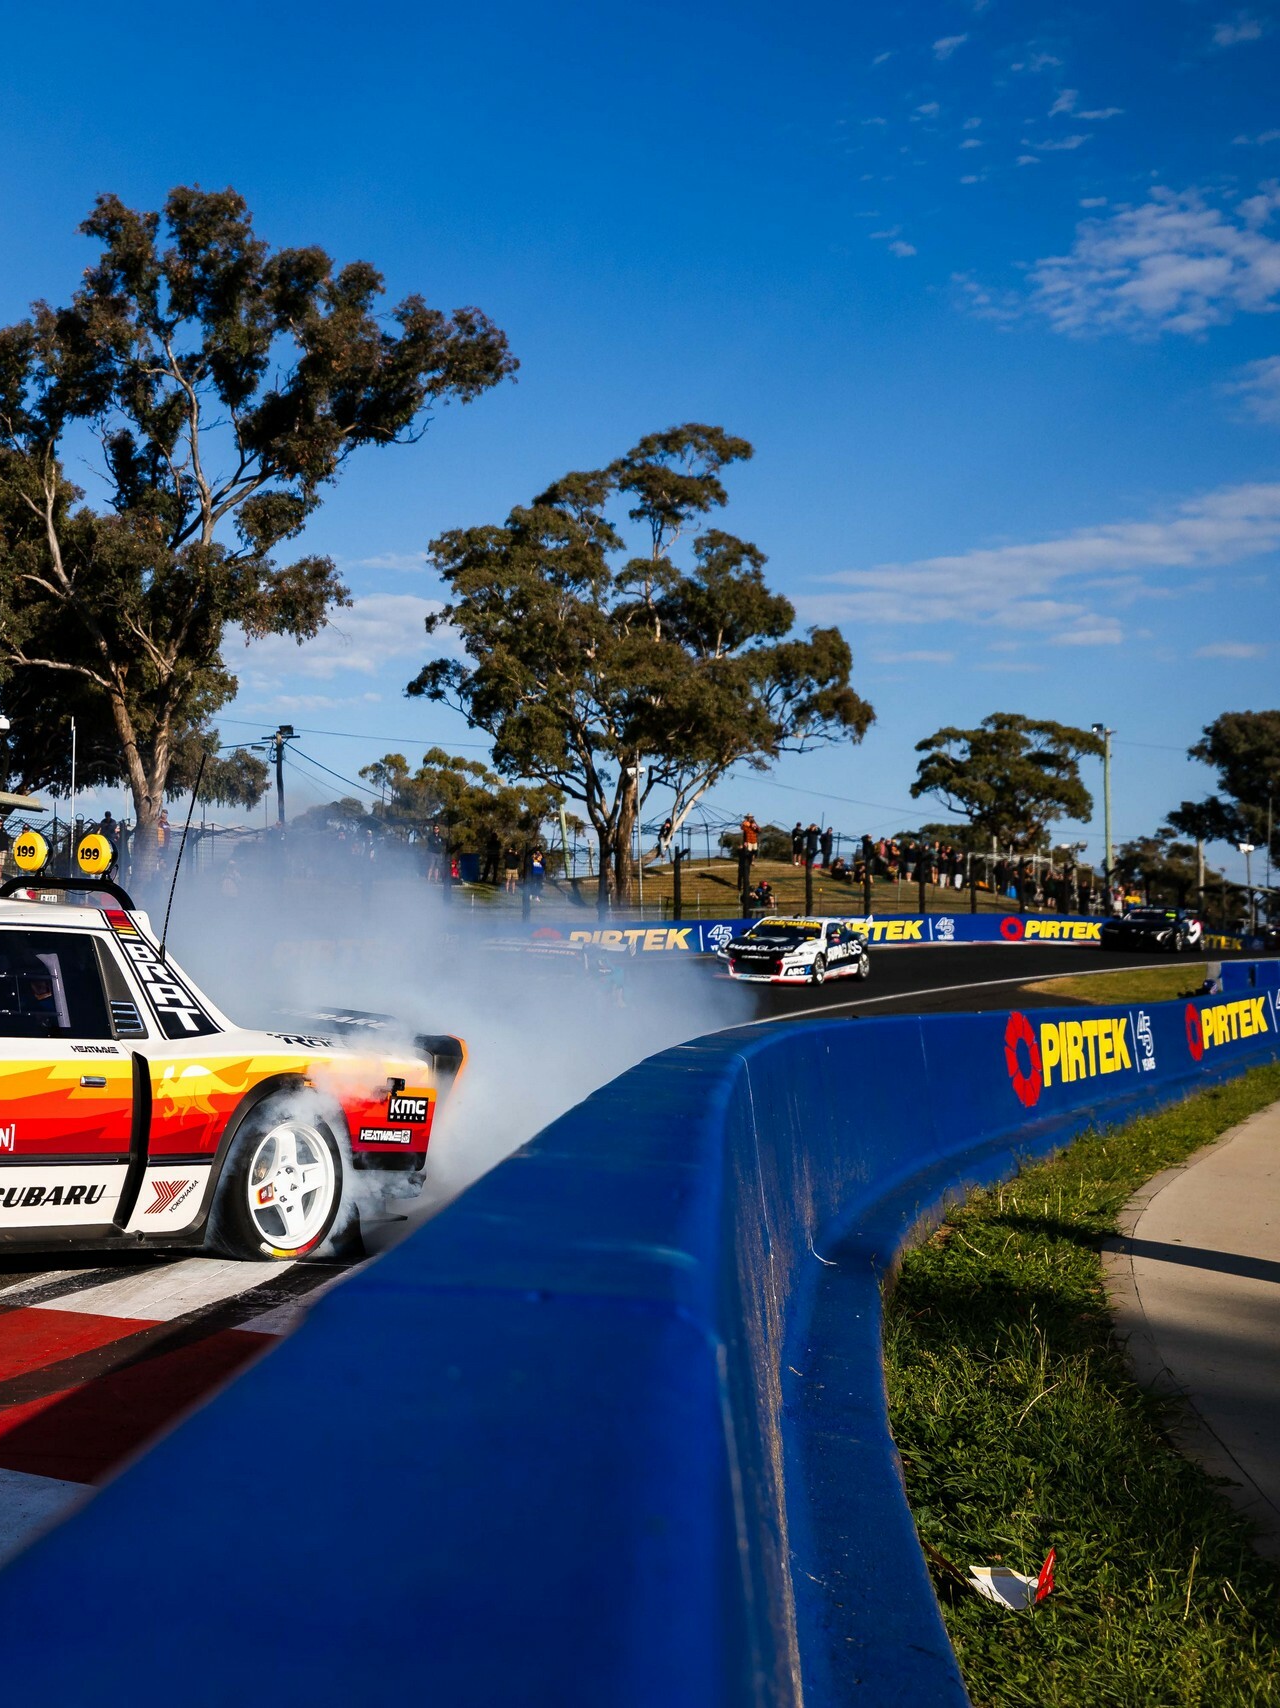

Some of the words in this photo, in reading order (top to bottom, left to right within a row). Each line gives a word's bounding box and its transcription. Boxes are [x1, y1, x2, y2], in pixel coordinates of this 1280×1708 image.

[16, 845, 35, 858] 199
[80, 847, 100, 860] 199
[935, 916, 955, 935] 45
[1024, 920, 1103, 940] PIRTEK
[123, 942, 201, 1031] BRAT
[1201, 996, 1269, 1050] PIRTEK
[1136, 1010, 1154, 1057] 45
[1040, 1017, 1132, 1087] PIRTEK
[389, 1098, 428, 1115] KMC
[360, 1129, 402, 1142] HEATWAVE
[168, 1179, 199, 1213] YOKOHAMA
